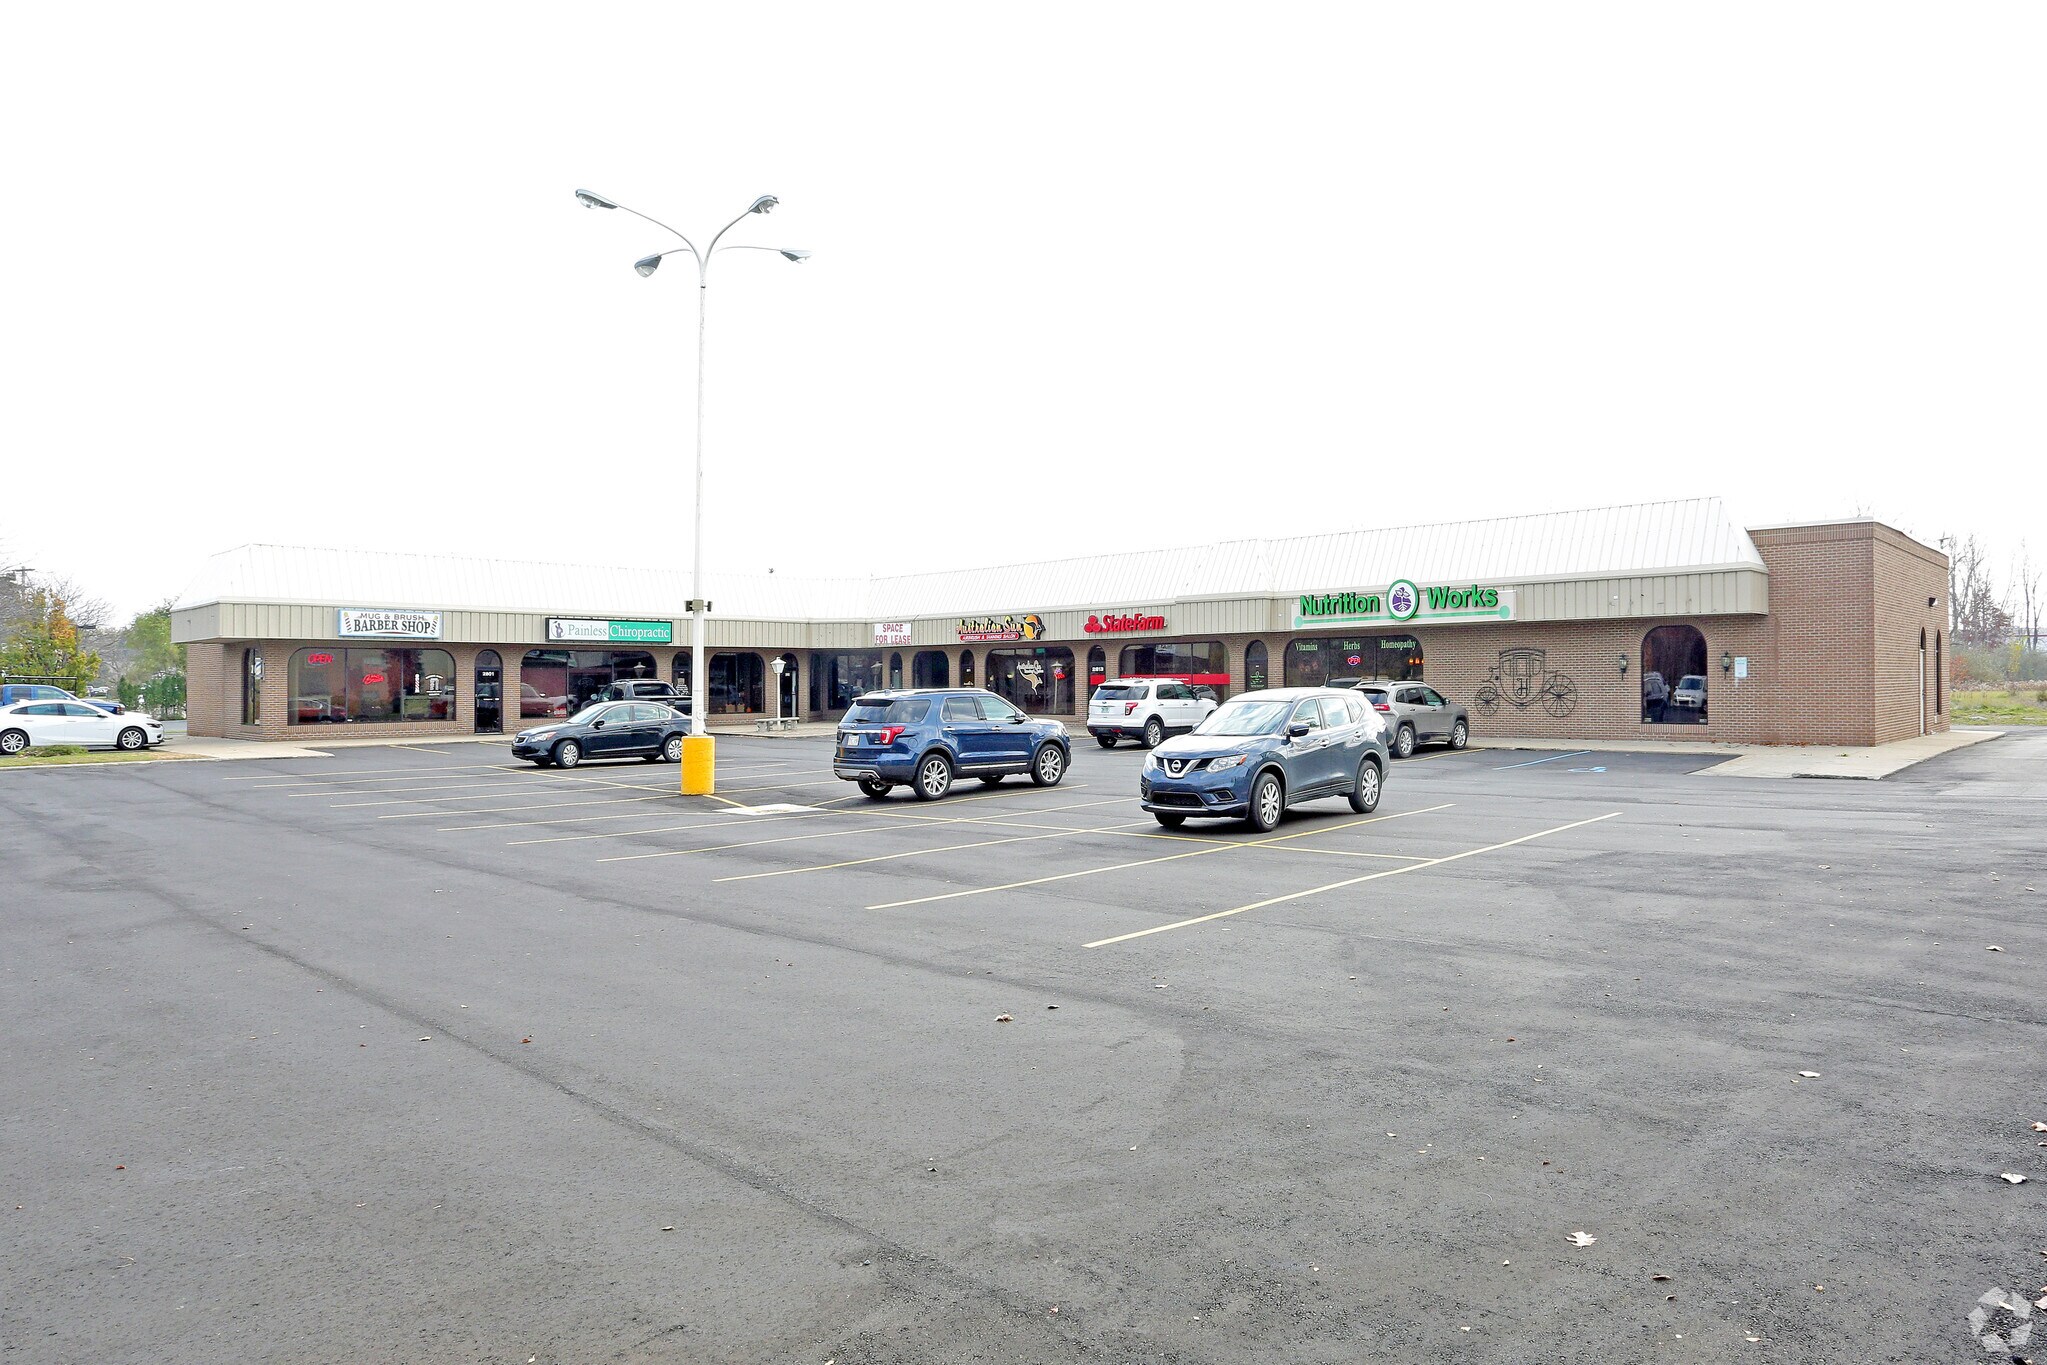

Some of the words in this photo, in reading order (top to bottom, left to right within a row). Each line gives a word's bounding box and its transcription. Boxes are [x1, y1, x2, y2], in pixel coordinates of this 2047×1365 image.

[1300, 592, 1380, 616] Nutrition
[1426, 584, 1498, 610] Works
[354, 619, 399, 632] BARBER
[401, 620, 431, 634] SHOP
[882, 624, 903, 632] SPACE
[956, 618, 1003, 634] Australian
[1003, 615, 1023, 632] Sun
[568, 624, 607, 637] Painless
[609, 625, 669, 640] Chiropractic
[875, 635, 888, 645] FOR
[890, 635, 911, 645] LEASE
[1343, 641, 1360, 650] Herbs
[1381, 640, 1417, 651] Homeopathy
[1295, 642, 1318, 651] Vitamins
[308, 653, 333, 664] OPEN
